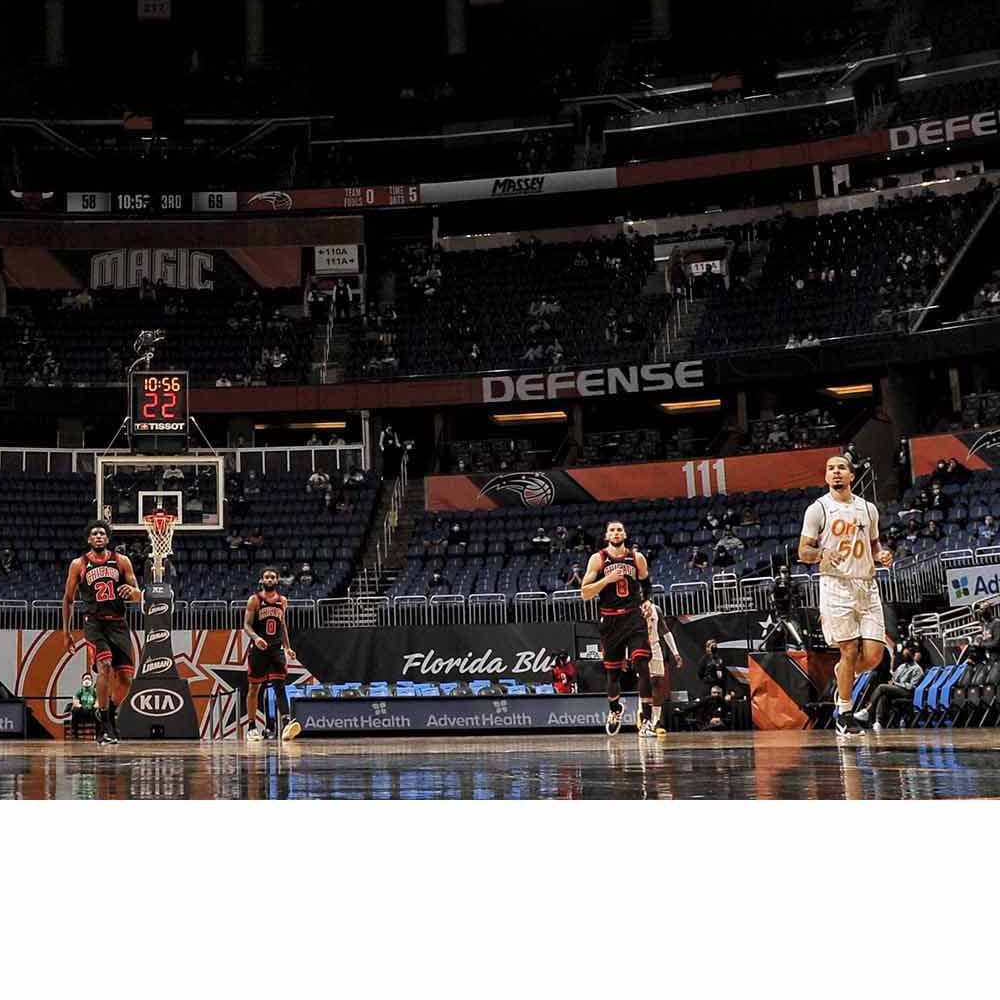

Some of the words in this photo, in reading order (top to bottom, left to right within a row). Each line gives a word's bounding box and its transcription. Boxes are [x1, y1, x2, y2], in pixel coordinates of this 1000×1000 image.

[408, 186, 418, 202] 5
[491, 175, 545, 195] MASSEY
[365, 188, 375, 205] 0
[88, 248, 215, 292] MAGIC
[143, 376, 181, 392] 10:56
[481, 359, 705, 404] DEFENSE
[143, 392, 177, 419] 22
[148, 422, 186, 431] TISSOT
[681, 458, 727, 499] 111
[839, 540, 865, 562] 50
[94, 580, 117, 602] 21
[265, 618, 277, 636] 0
[401, 648, 508, 676] Florida
[511, 647, 558, 674] Blu
[139, 694, 176, 711] KIA
[304, 715, 411, 730] AdventHealth
[426, 713, 533, 728] AdventHealth
